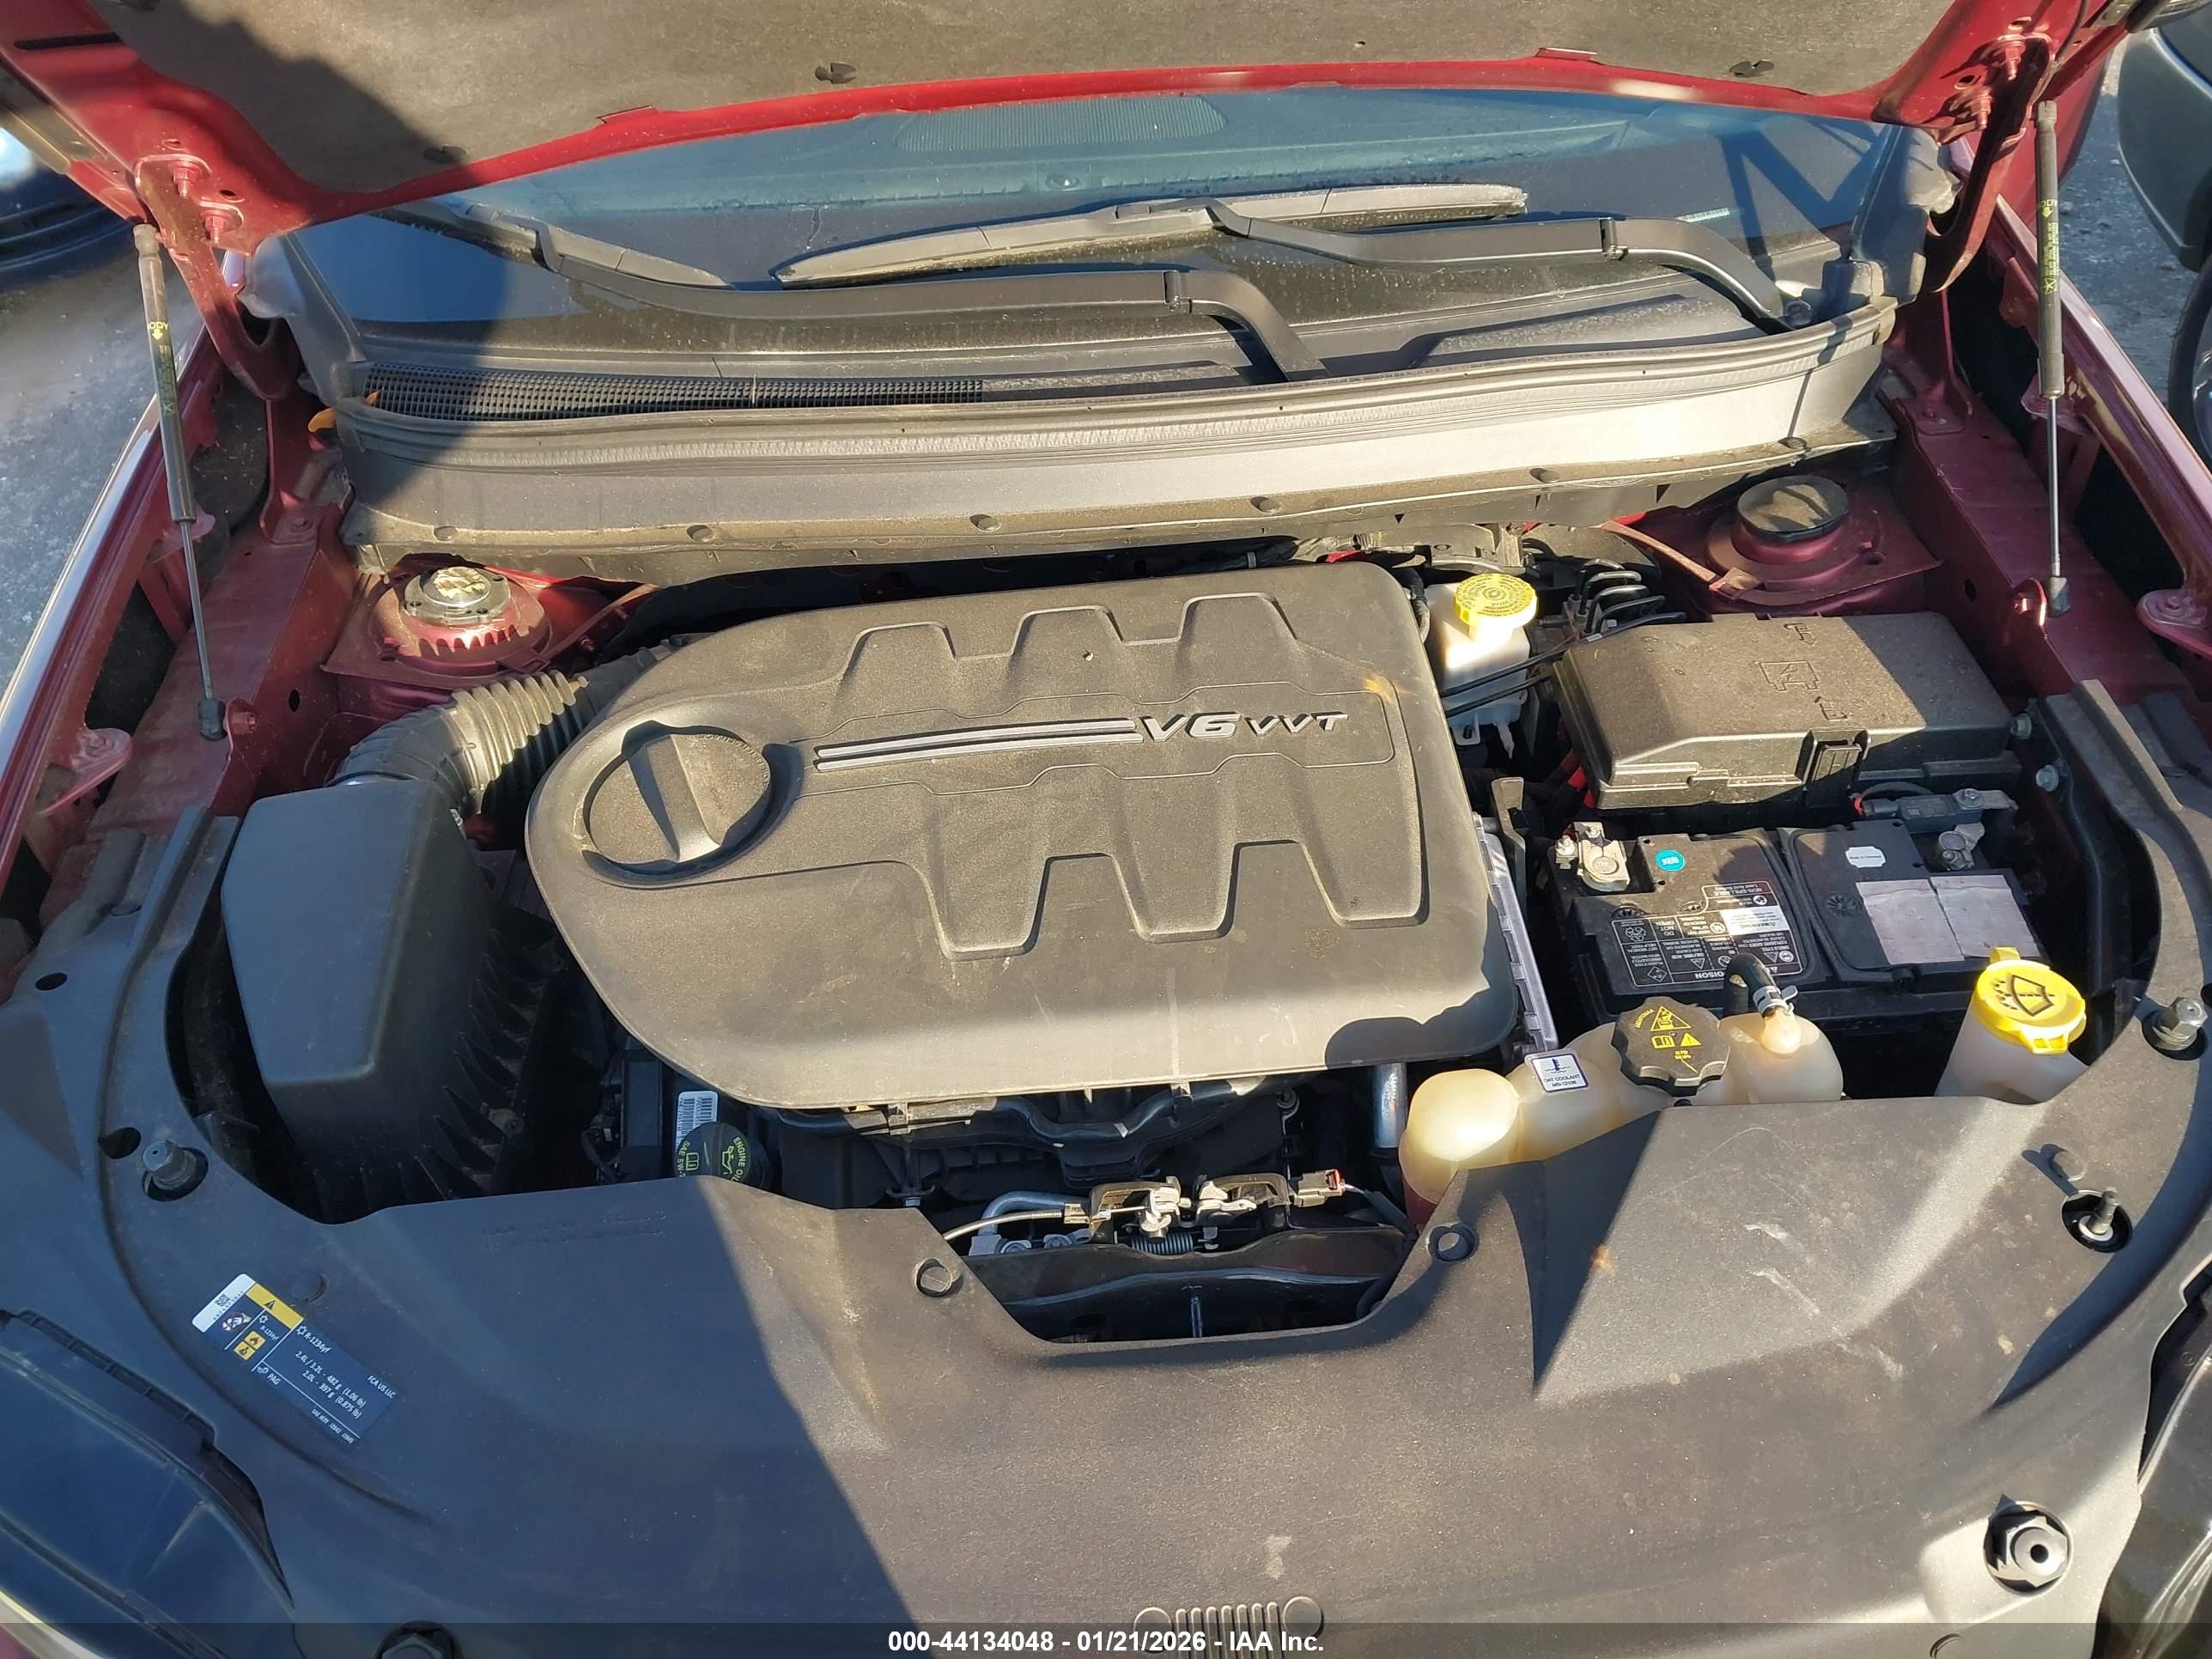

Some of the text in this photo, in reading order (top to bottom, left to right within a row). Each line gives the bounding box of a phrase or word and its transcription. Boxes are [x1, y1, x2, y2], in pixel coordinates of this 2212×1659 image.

[1139, 711, 1349, 742] V6 VVT
[678, 1140, 690, 1156] SAE
[731, 1137, 746, 1182] ENGINE OIL
[304, 1332, 331, 1353] R-1234yf
[268, 1373, 281, 1385] PAG
[367, 1375, 396, 1399] FCA US LLC
[302, 1370, 315, 1382] 2.0L
[319, 1383, 331, 1393] 397
[335, 1396, 354, 1412] (0.875
[352, 1408, 362, 1419] lb)
[327, 1375, 339, 1386] 482
[342, 1387, 357, 1401] (1.06
[356, 1397, 366, 1408] lb)
[311, 1409, 321, 1417] SAE
